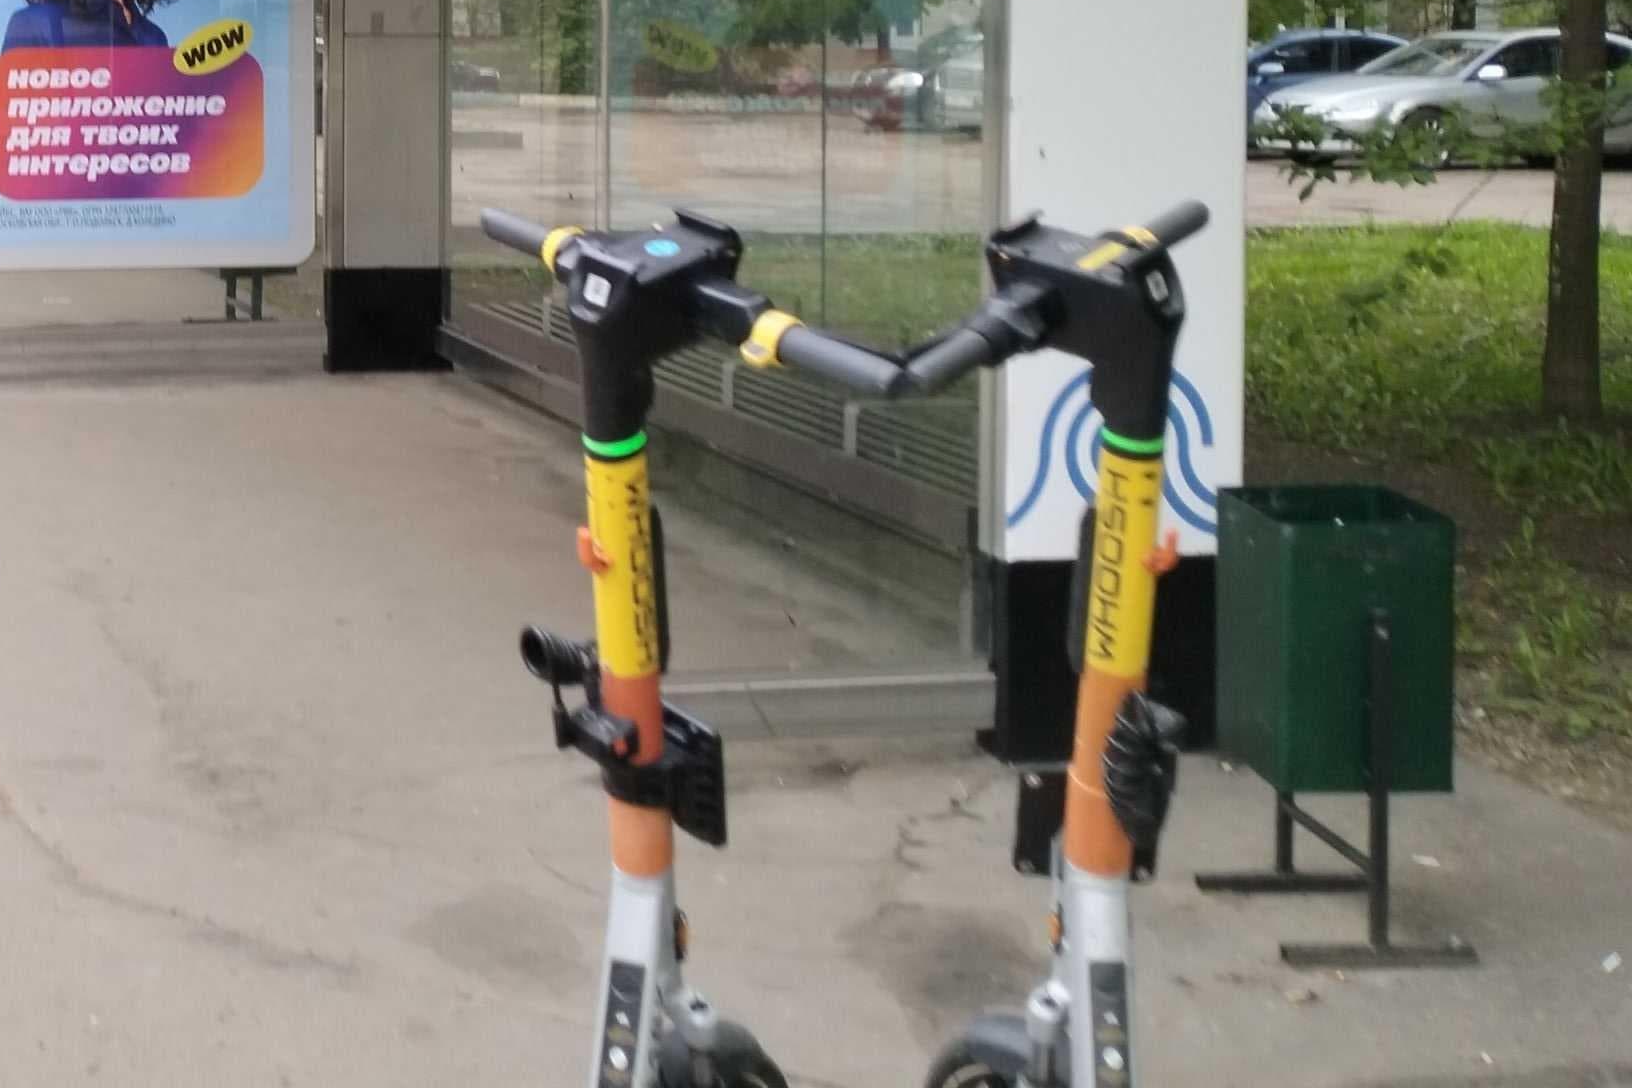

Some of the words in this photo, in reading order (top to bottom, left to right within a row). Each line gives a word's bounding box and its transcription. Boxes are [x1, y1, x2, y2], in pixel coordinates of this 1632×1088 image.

[6, 67, 111, 90] новое
[6, 95, 227, 124] приложение
[5, 125, 71, 151] для
[80, 124, 179, 146] твоих
[7, 152, 191, 182] интересов
[1088, 468, 1128, 661] WHOOSH
